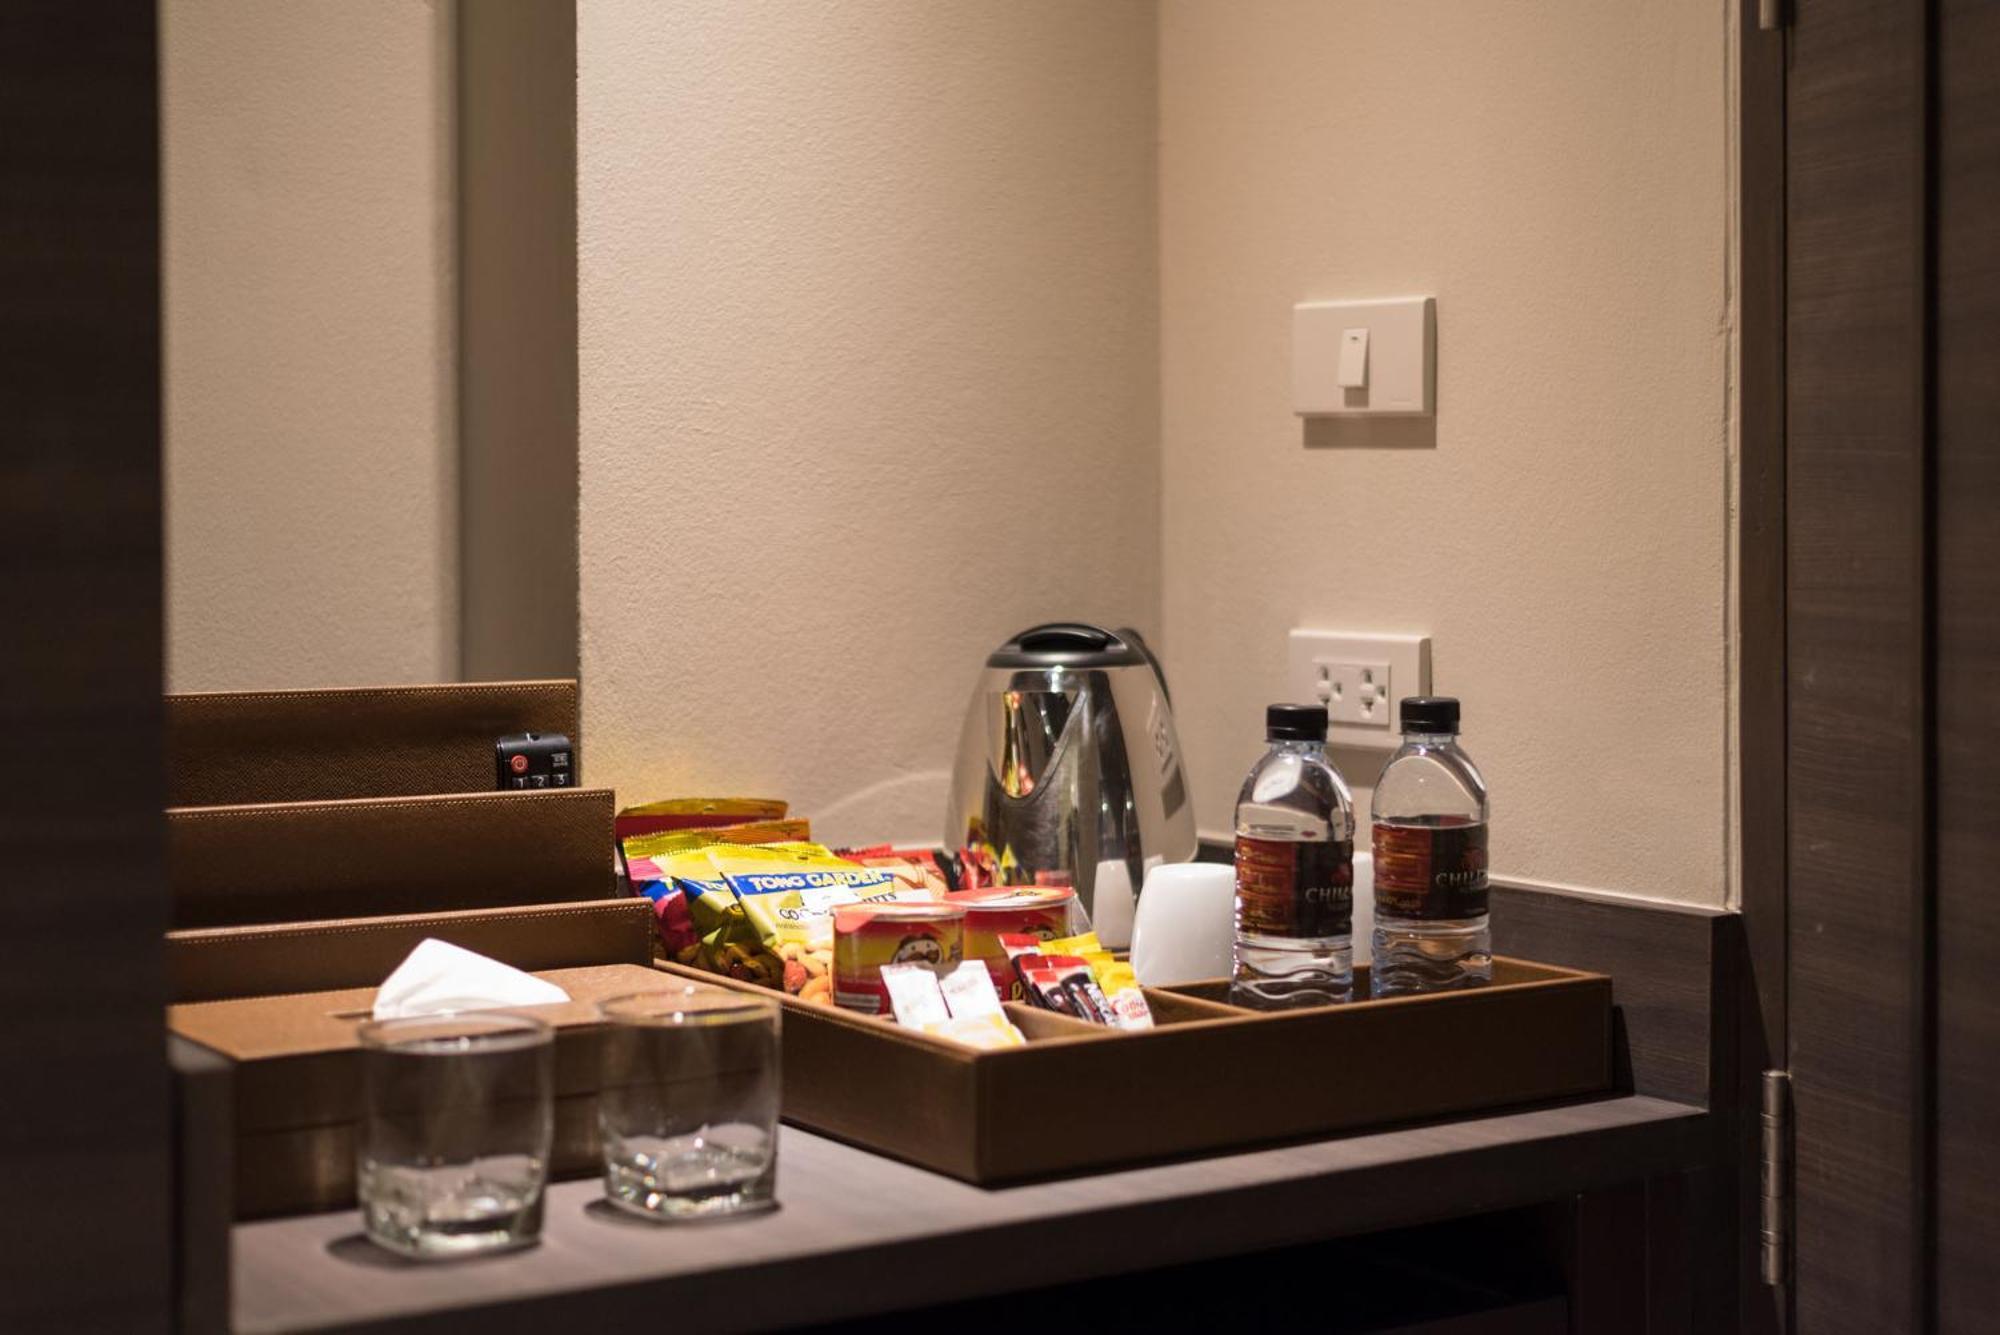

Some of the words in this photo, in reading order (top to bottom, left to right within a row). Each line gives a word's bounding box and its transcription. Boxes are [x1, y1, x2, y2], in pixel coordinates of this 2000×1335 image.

[537, 776, 545, 787] 2
[748, 876, 806, 891] TONG
[806, 871, 883, 887] GARDEN
